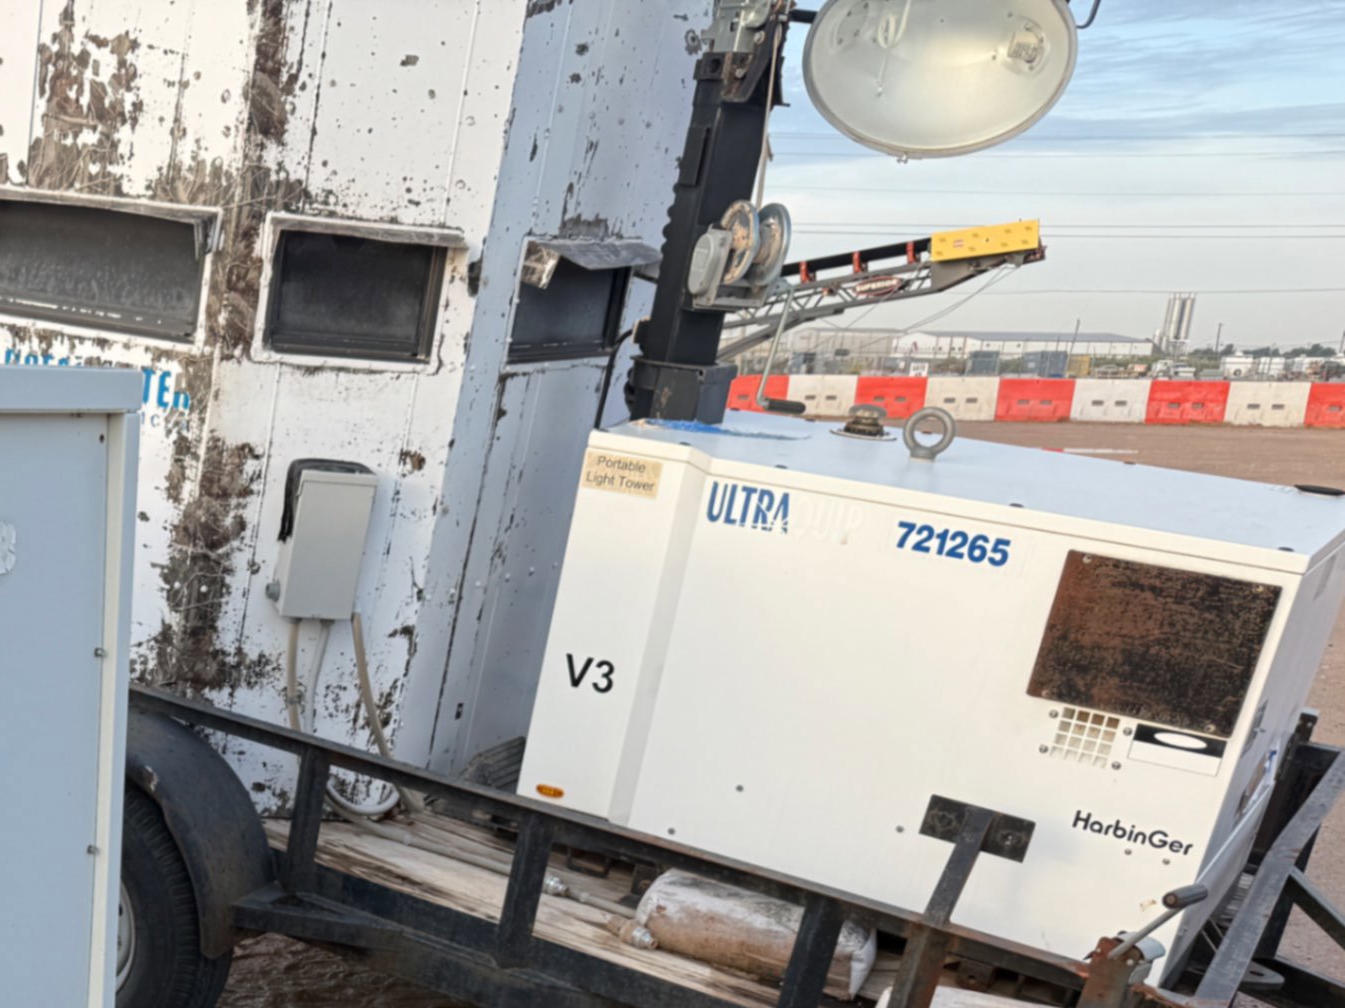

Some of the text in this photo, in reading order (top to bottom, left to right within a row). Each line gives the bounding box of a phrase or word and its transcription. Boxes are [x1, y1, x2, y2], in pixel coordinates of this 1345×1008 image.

[586, 471, 655, 491] Light Tower
[597, 455, 646, 473] Portable
[896, 521, 1011, 567] 721265
[566, 653, 614, 693] V3
[1072, 810, 1193, 855] HarbinGer
